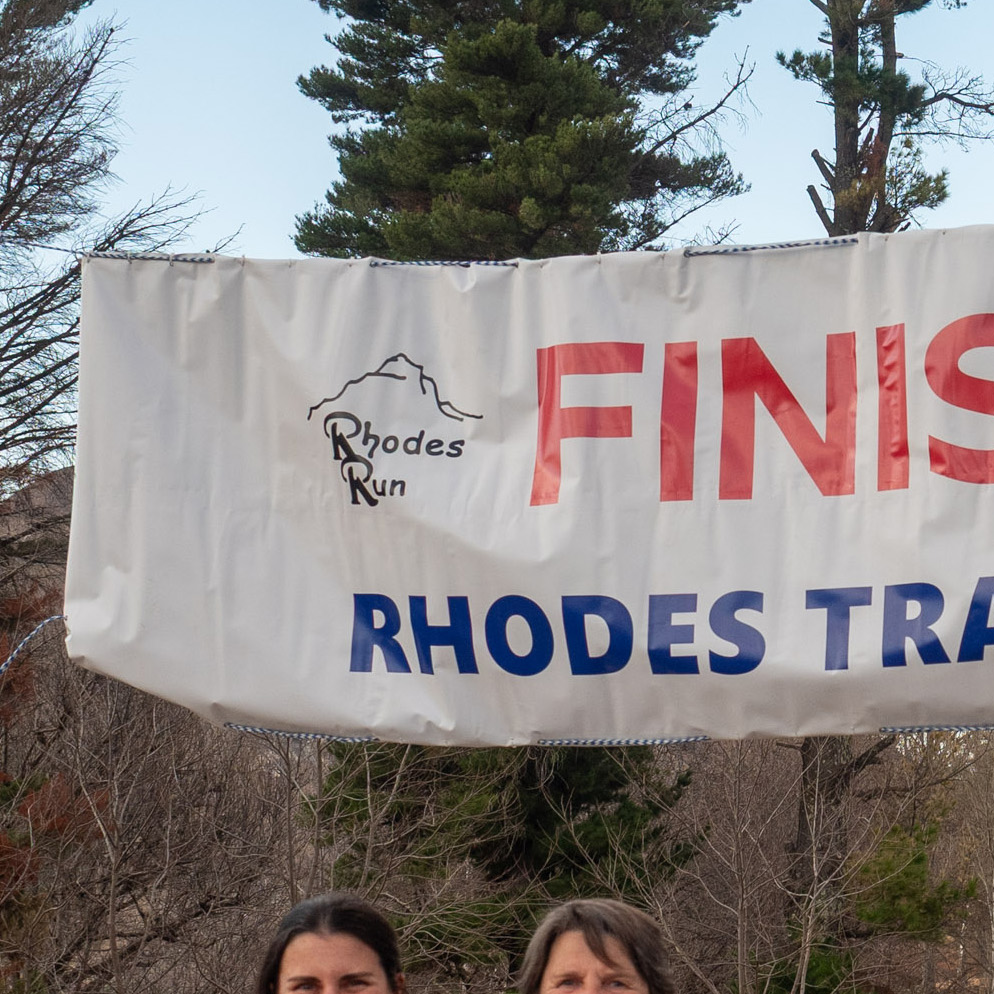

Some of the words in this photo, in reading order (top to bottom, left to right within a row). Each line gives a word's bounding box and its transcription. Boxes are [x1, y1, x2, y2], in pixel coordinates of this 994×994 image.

[324, 411, 465, 461] Rhodes
[340, 455, 407, 507] Run
[351, 591, 762, 676] RHODES
